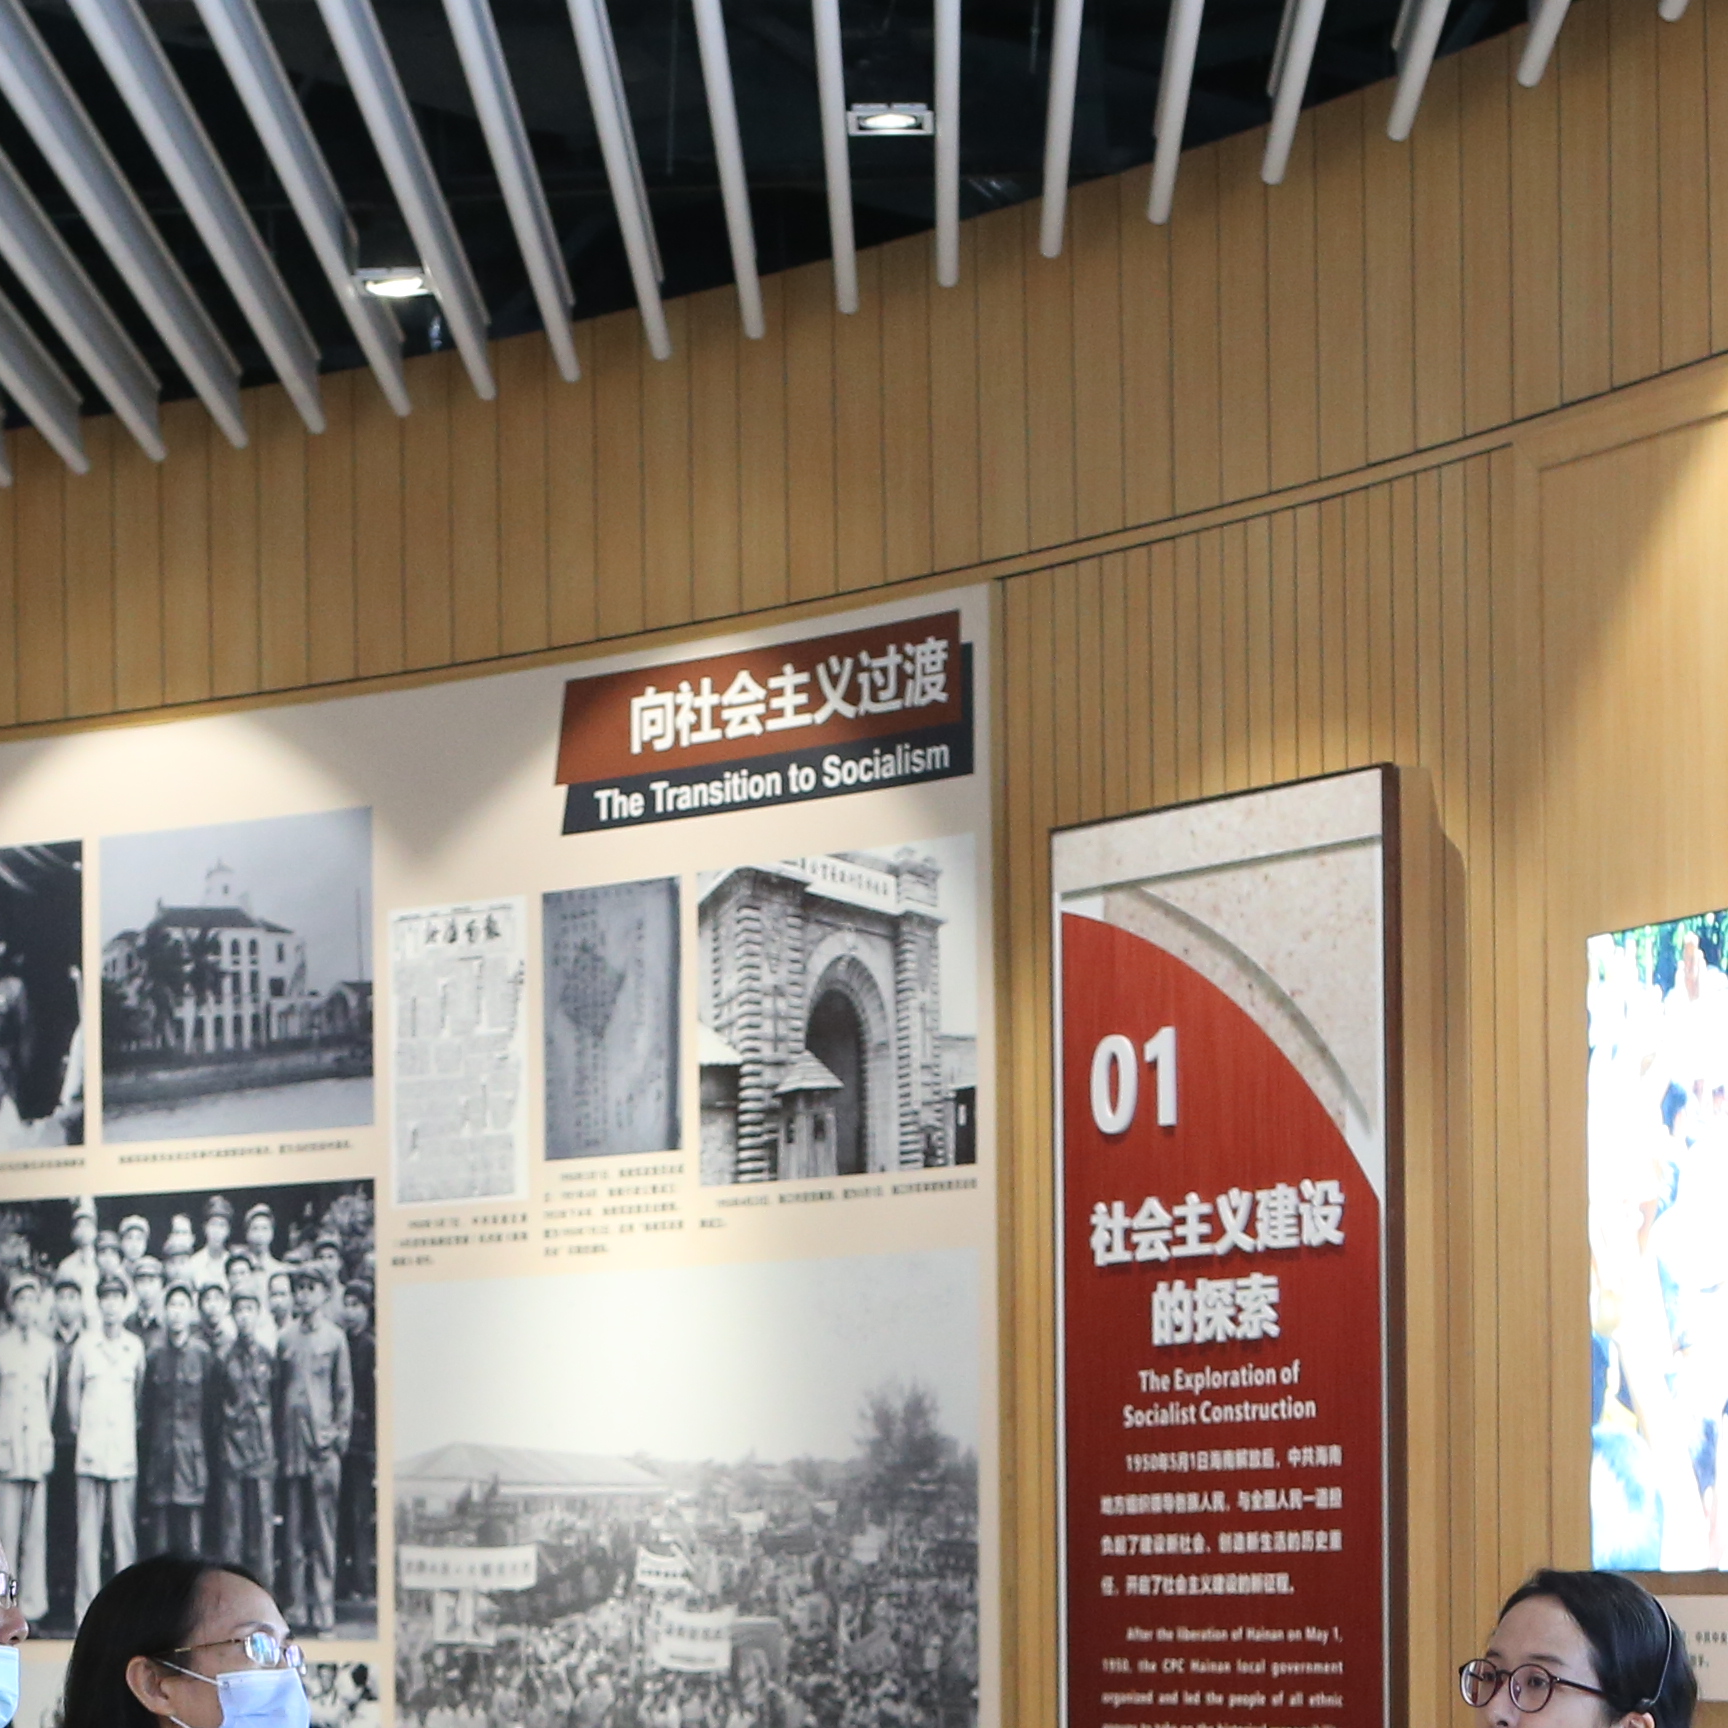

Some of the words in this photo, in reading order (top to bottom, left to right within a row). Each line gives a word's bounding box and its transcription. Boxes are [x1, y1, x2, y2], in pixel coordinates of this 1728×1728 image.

[630, 636, 949, 755] 向社会主义过渡
[593, 789, 644, 822] The
[650, 769, 781, 812] Transition
[788, 763, 816, 793] to
[822, 742, 950, 788] Socialism
[1089, 1025, 1178, 1135] 01
[1089, 1178, 1345, 1267] 社会主义建设
[1151, 1272, 1280, 1347] 的探索
[1122, 1404, 1197, 1428] Socialist
[1199, 1396, 1316, 1424] Construction
[1138, 1369, 1170, 1393] The
[1173, 1364, 1276, 1395] Exploration
[1280, 1359, 1301, 1384] of
[1236, 1659, 1266, 1674] local
[1271, 1661, 1343, 1678] government
[1305, 1626, 1329, 1645] May
